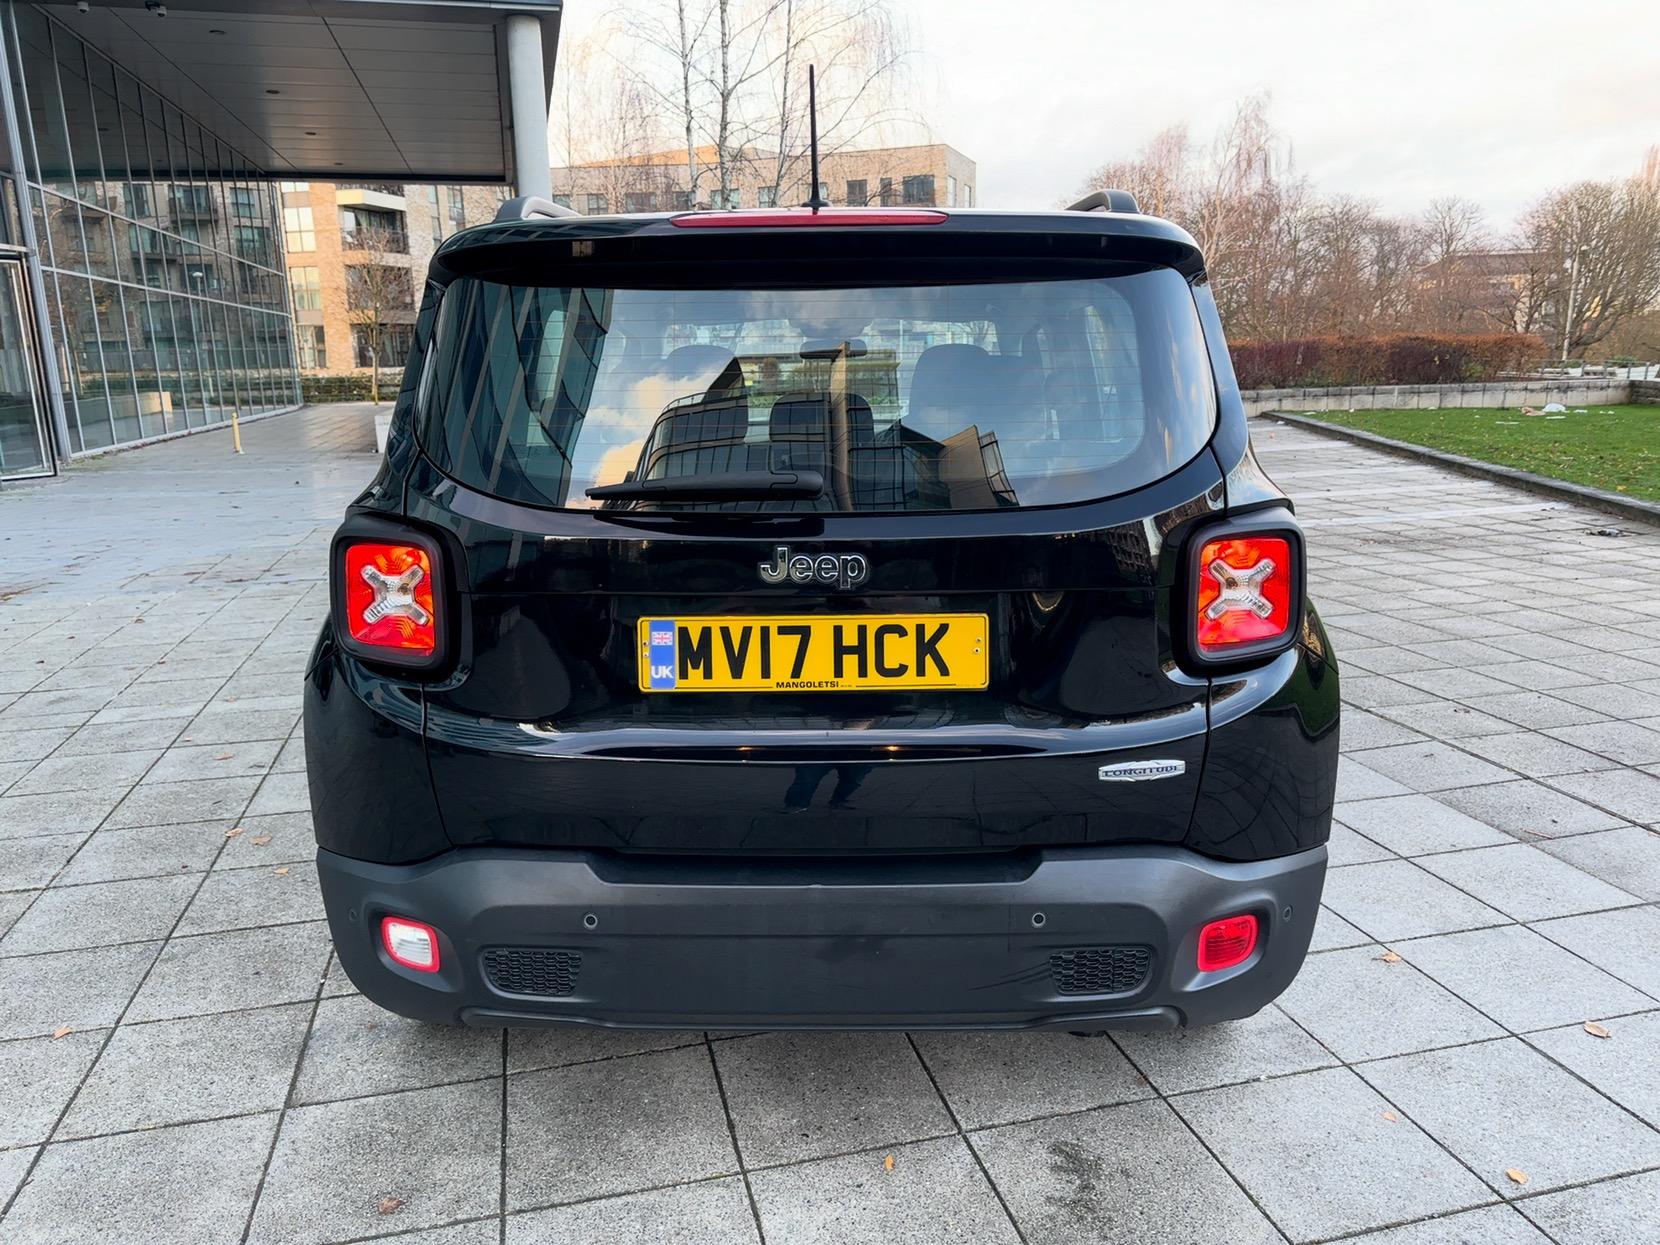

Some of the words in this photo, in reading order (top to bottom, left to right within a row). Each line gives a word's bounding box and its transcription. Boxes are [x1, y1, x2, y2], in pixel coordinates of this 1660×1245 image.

[759, 546, 866, 590] Jeep
[651, 665, 674, 679] UK
[678, 625, 811, 680] MV17
[833, 623, 950, 678] HCK
